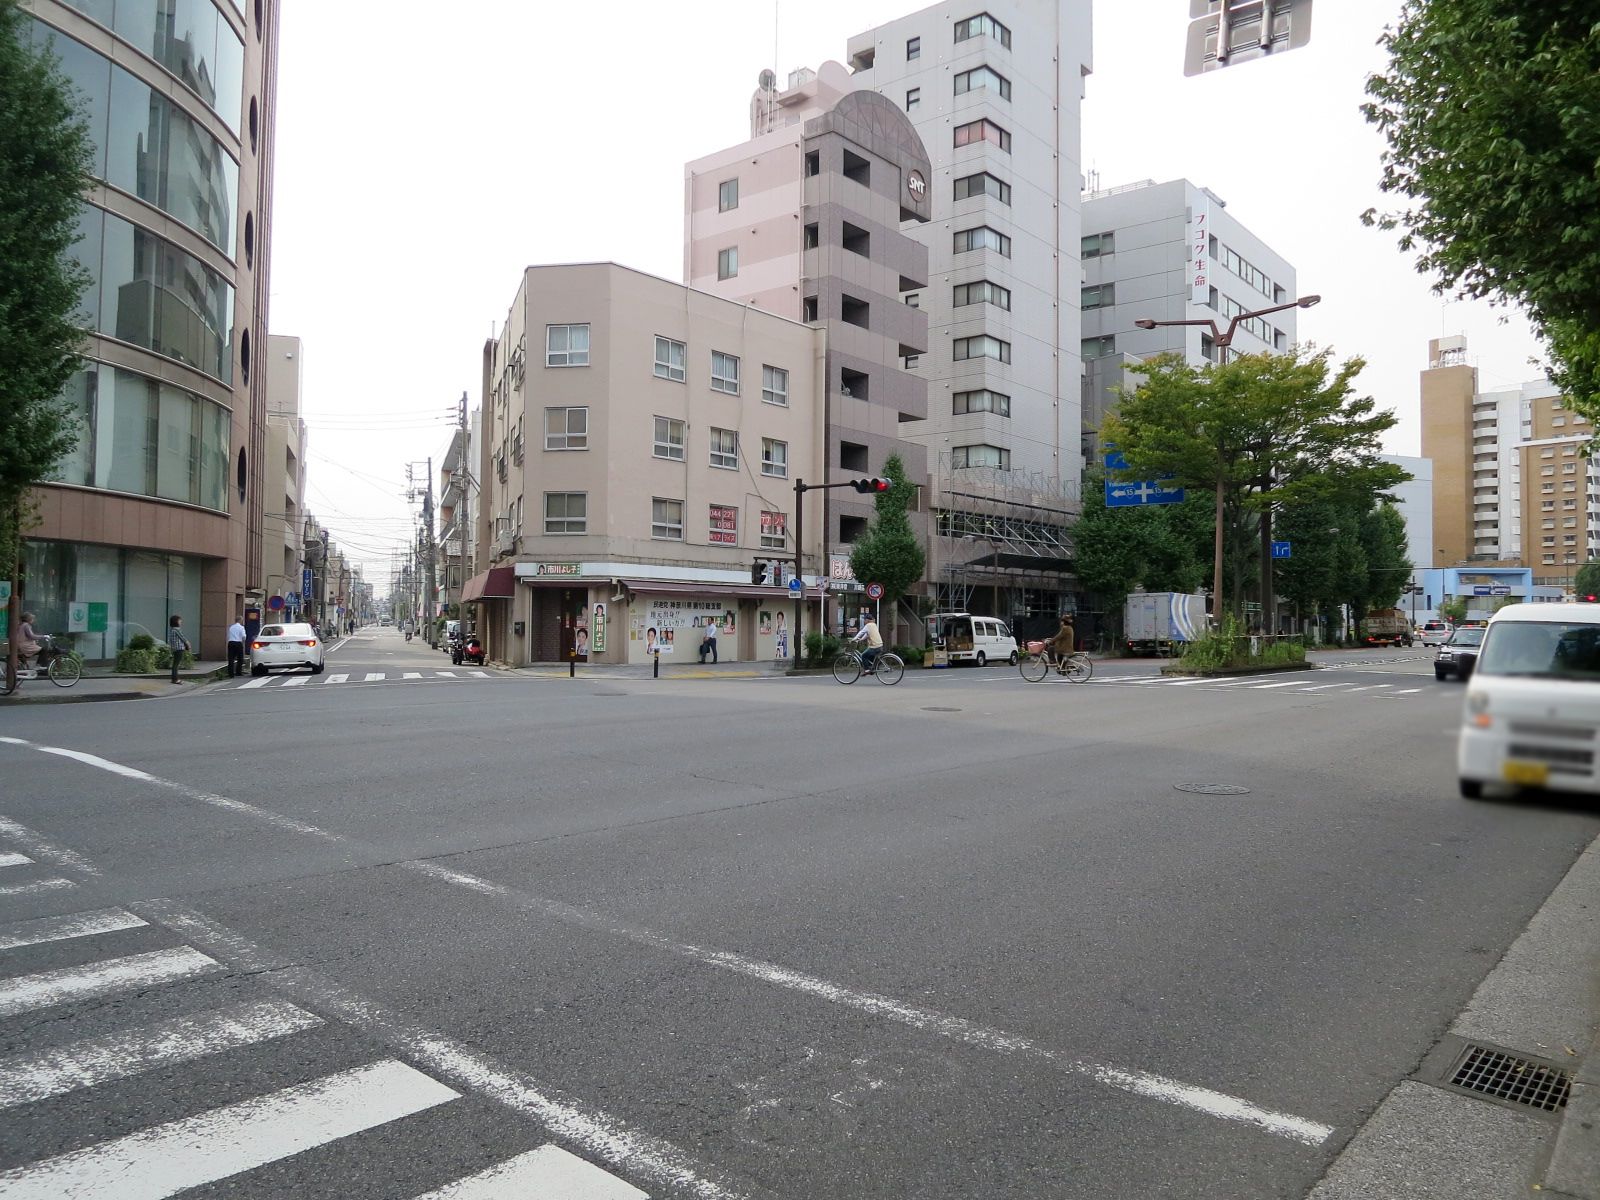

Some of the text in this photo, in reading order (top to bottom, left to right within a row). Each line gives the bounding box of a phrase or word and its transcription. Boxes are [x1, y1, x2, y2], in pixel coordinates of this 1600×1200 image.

[1194, 214, 1206, 287] フコク生命
[547, 565, 577, 574] 市川よし子
[832, 560, 856, 580] はん
[595, 616, 604, 647] 市川よし子
